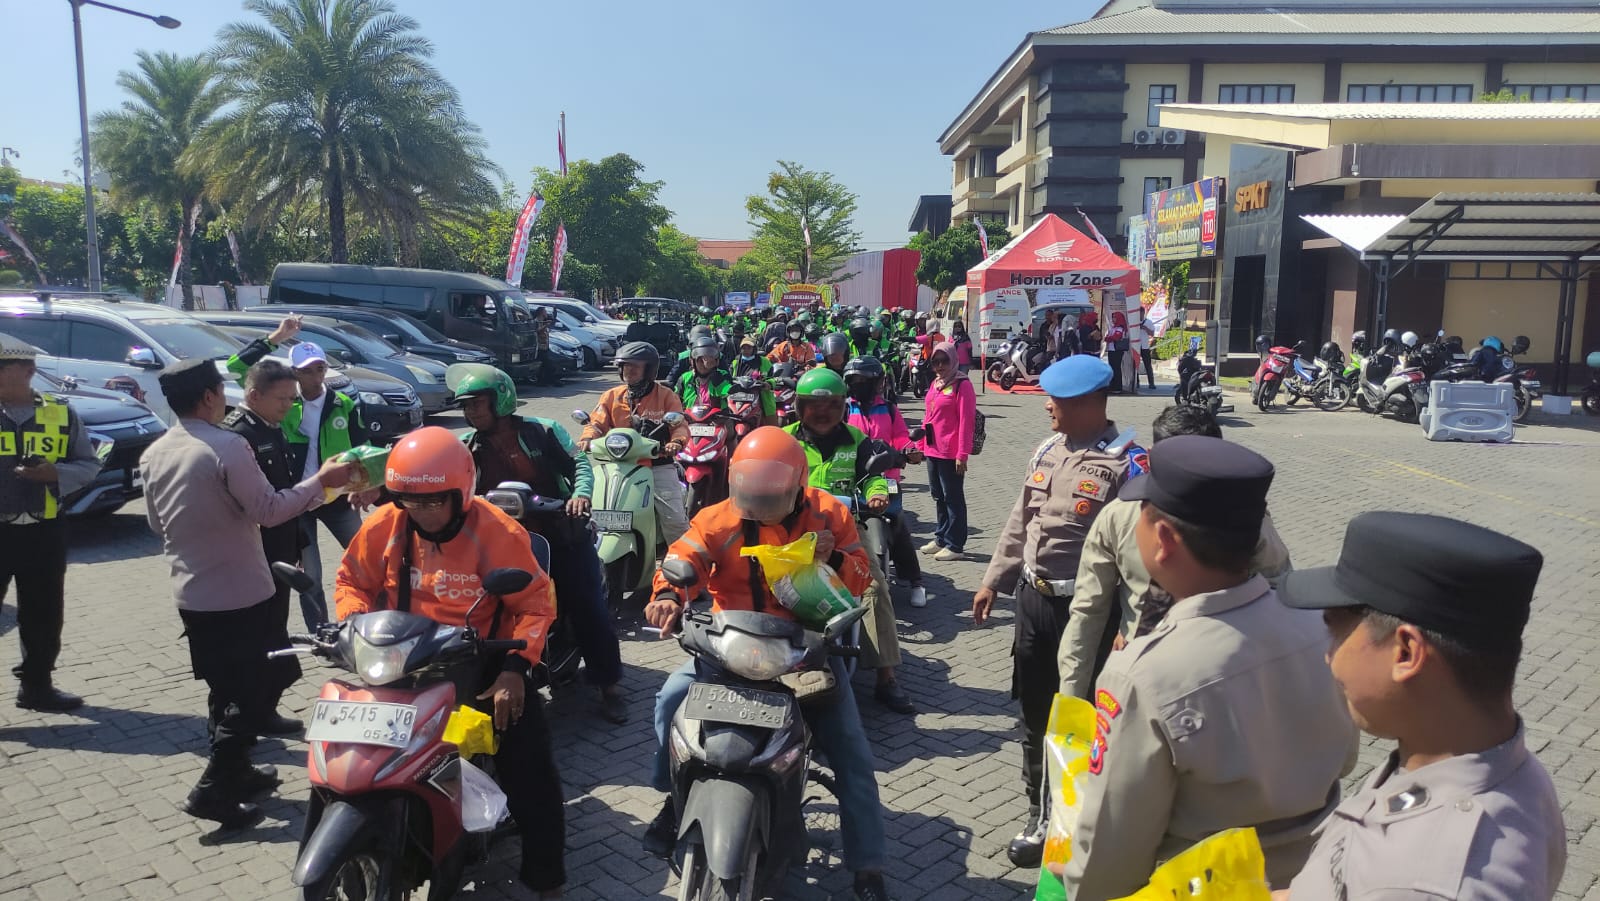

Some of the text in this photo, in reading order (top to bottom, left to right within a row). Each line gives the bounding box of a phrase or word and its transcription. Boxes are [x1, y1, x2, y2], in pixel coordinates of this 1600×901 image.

[1234, 180, 1270, 213] SPKT
[1204, 219, 1214, 234] 110
[1010, 272, 1113, 286] Honda Zone
[1079, 465, 1112, 480] POLRI
[435, 569, 479, 584] Shope
[317, 704, 329, 720] W
[339, 706, 379, 722] 5415
